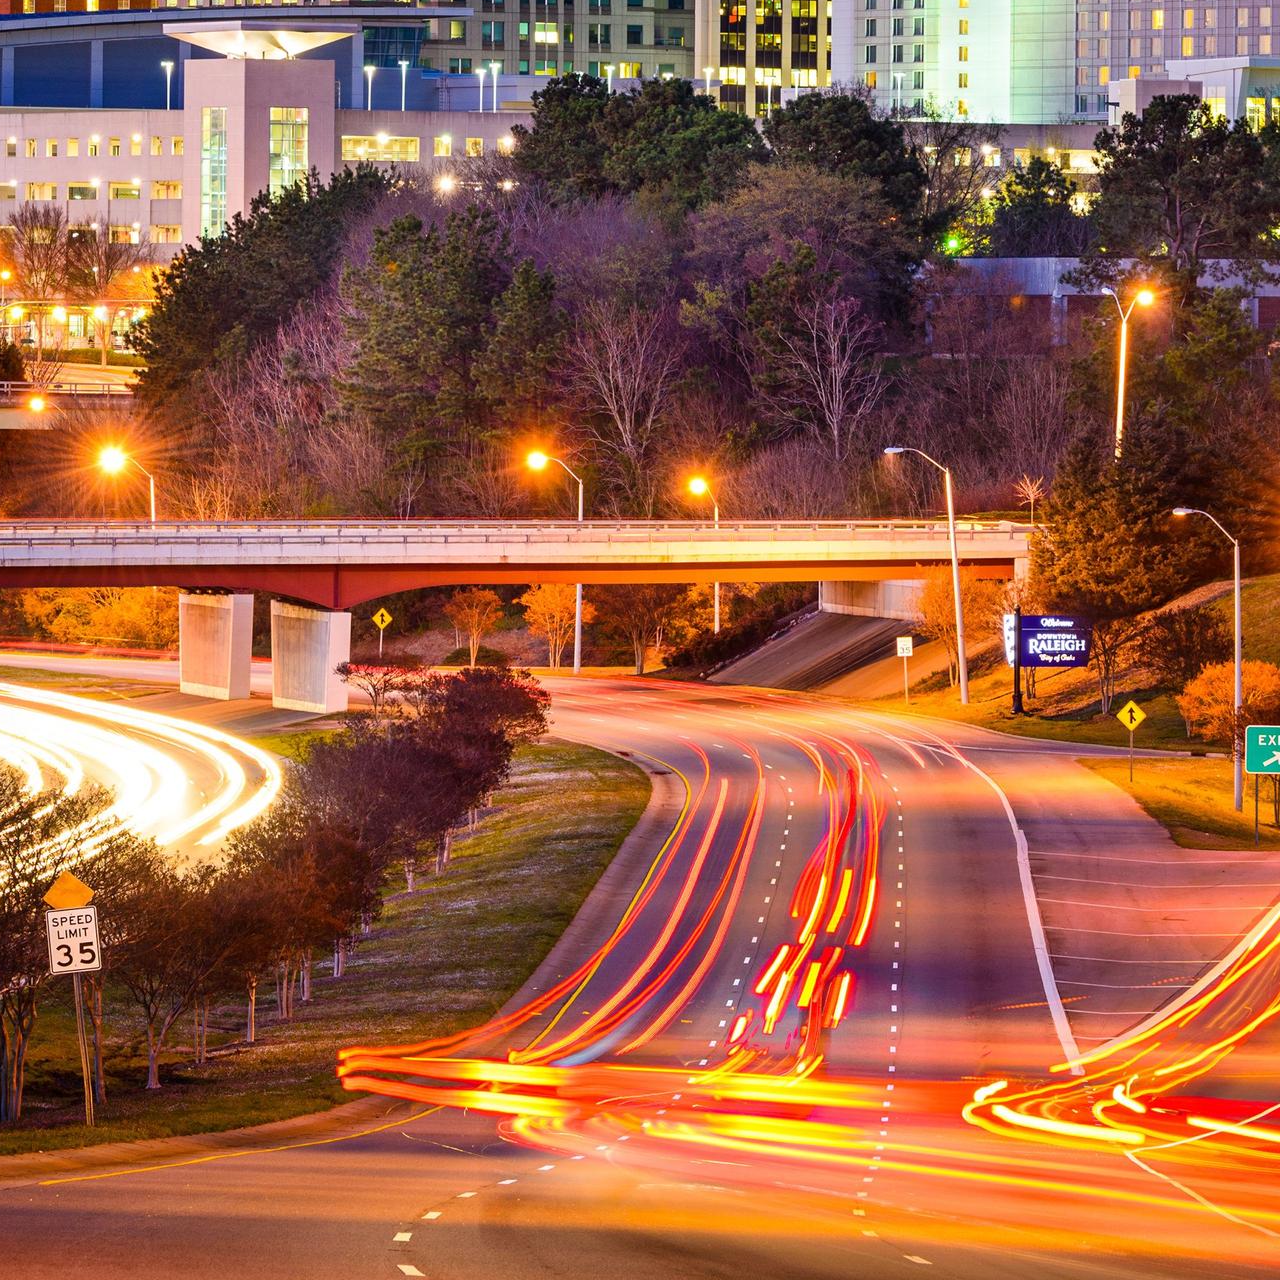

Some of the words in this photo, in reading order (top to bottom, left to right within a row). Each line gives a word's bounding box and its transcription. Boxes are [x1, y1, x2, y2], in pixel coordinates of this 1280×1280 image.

[1028, 638, 1086, 654] RALEIGH
[52, 914, 93, 927] SPEED
[57, 927, 89, 940] LIMIT
[56, 941, 96, 967] 35
